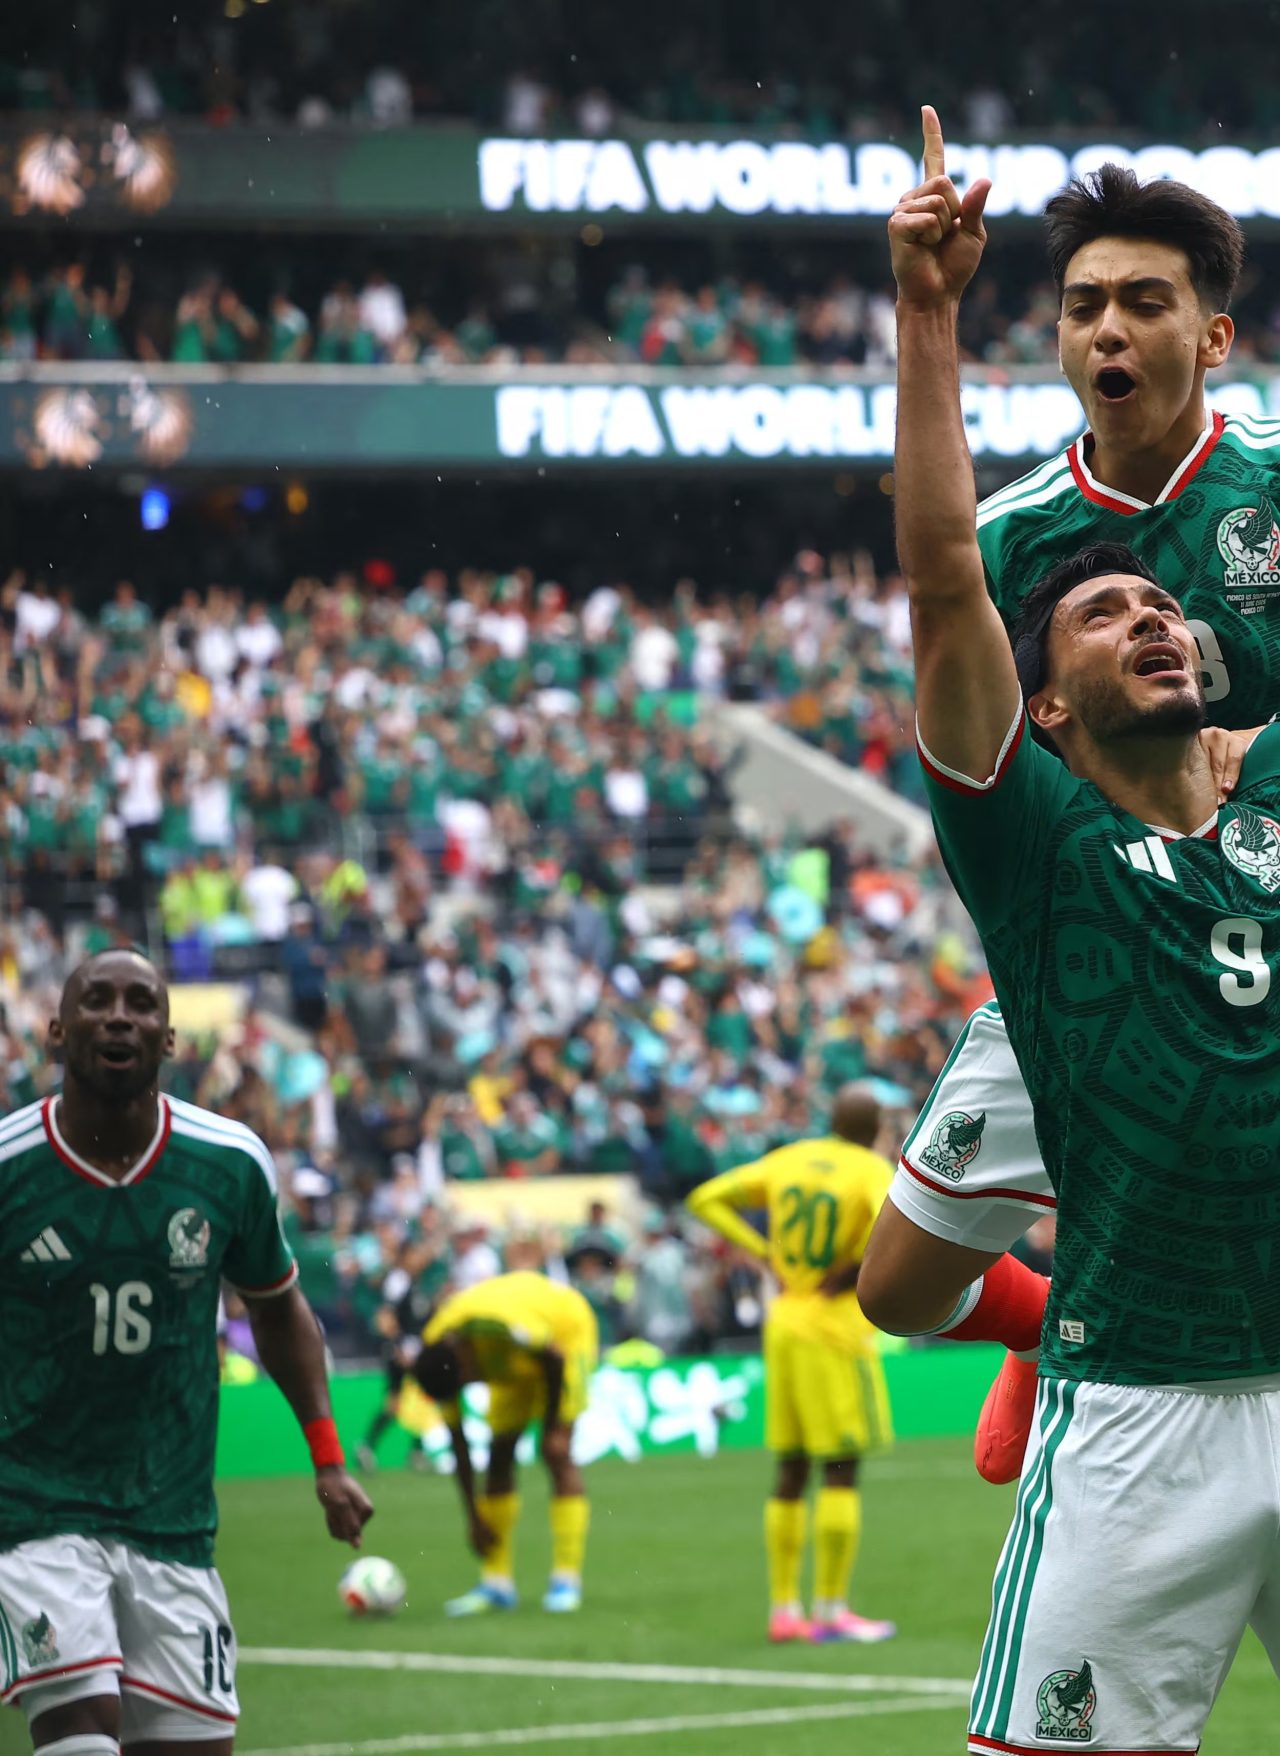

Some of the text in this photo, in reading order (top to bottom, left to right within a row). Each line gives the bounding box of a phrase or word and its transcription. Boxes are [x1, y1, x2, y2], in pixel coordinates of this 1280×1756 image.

[479, 138, 649, 212] FIFA
[644, 140, 917, 215] WORLD
[496, 385, 666, 457] FIFA
[1226, 569, 1280, 585] MÉXICO
[1210, 917, 1271, 1007] 9
[922, 1151, 961, 1180] MÉXICO
[780, 1185, 838, 1268] 20
[89, 1280, 153, 1356] 16
[1038, 1724, 1089, 1738] MÉXICO
